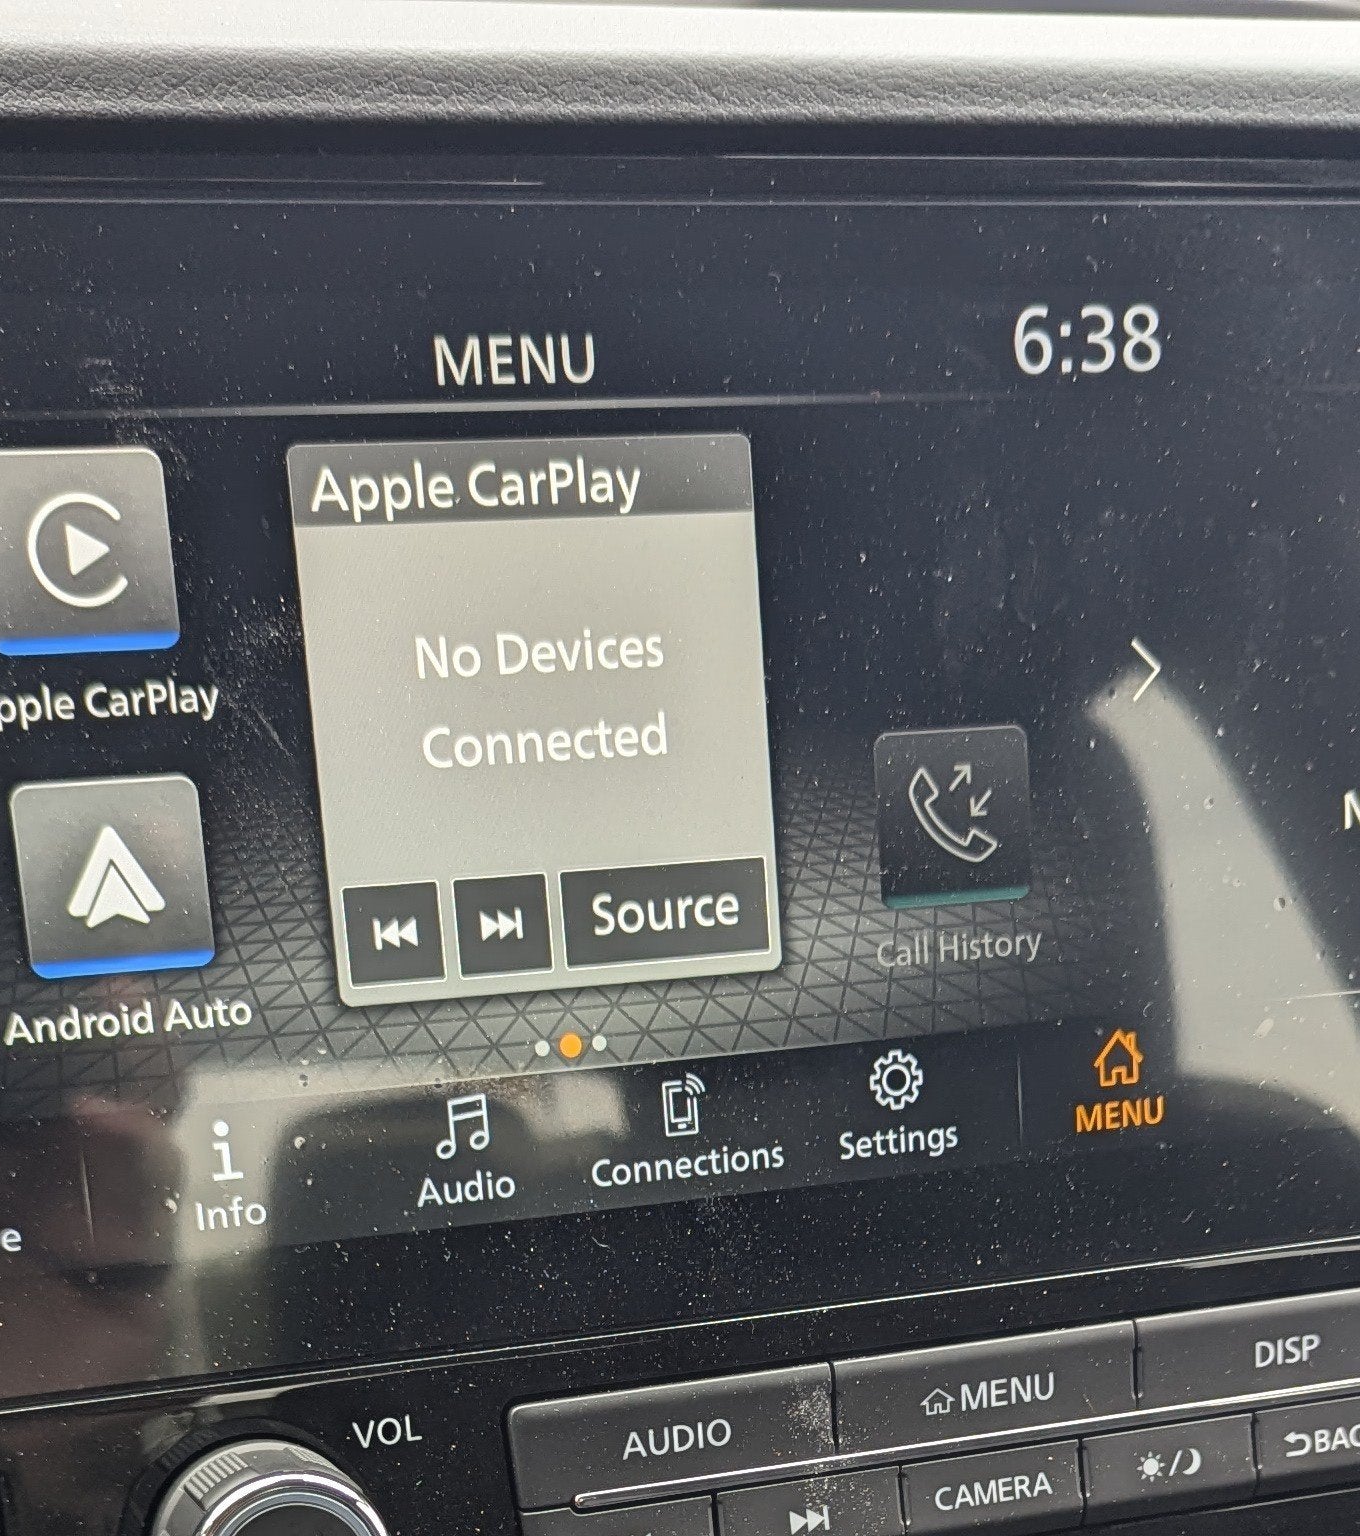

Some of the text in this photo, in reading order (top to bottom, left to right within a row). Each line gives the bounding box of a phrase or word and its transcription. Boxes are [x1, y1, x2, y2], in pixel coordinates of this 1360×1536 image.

[433, 333, 596, 387] MENU
[1013, 303, 1162, 376] 6:38
[309, 456, 642, 522] Apple CarPlay
[414, 624, 665, 678] No Devices
[83, 680, 220, 722] CarPlay
[422, 713, 669, 770] Connected
[591, 892, 741, 937] Source
[876, 928, 1041, 968] Call History
[3, 999, 253, 1047] Android Auto
[1074, 1096, 1165, 1134] MENU
[839, 1125, 958, 1161] Settings
[591, 1143, 785, 1188] Connections
[417, 1172, 516, 1208] Audio
[195, 1200, 268, 1233] Info
[1254, 1334, 1322, 1368] DISP
[960, 1373, 1056, 1411] MENU
[352, 1414, 423, 1449] VOL
[622, 1419, 733, 1461] AUDIO
[934, 1471, 1054, 1511] CAMERA
